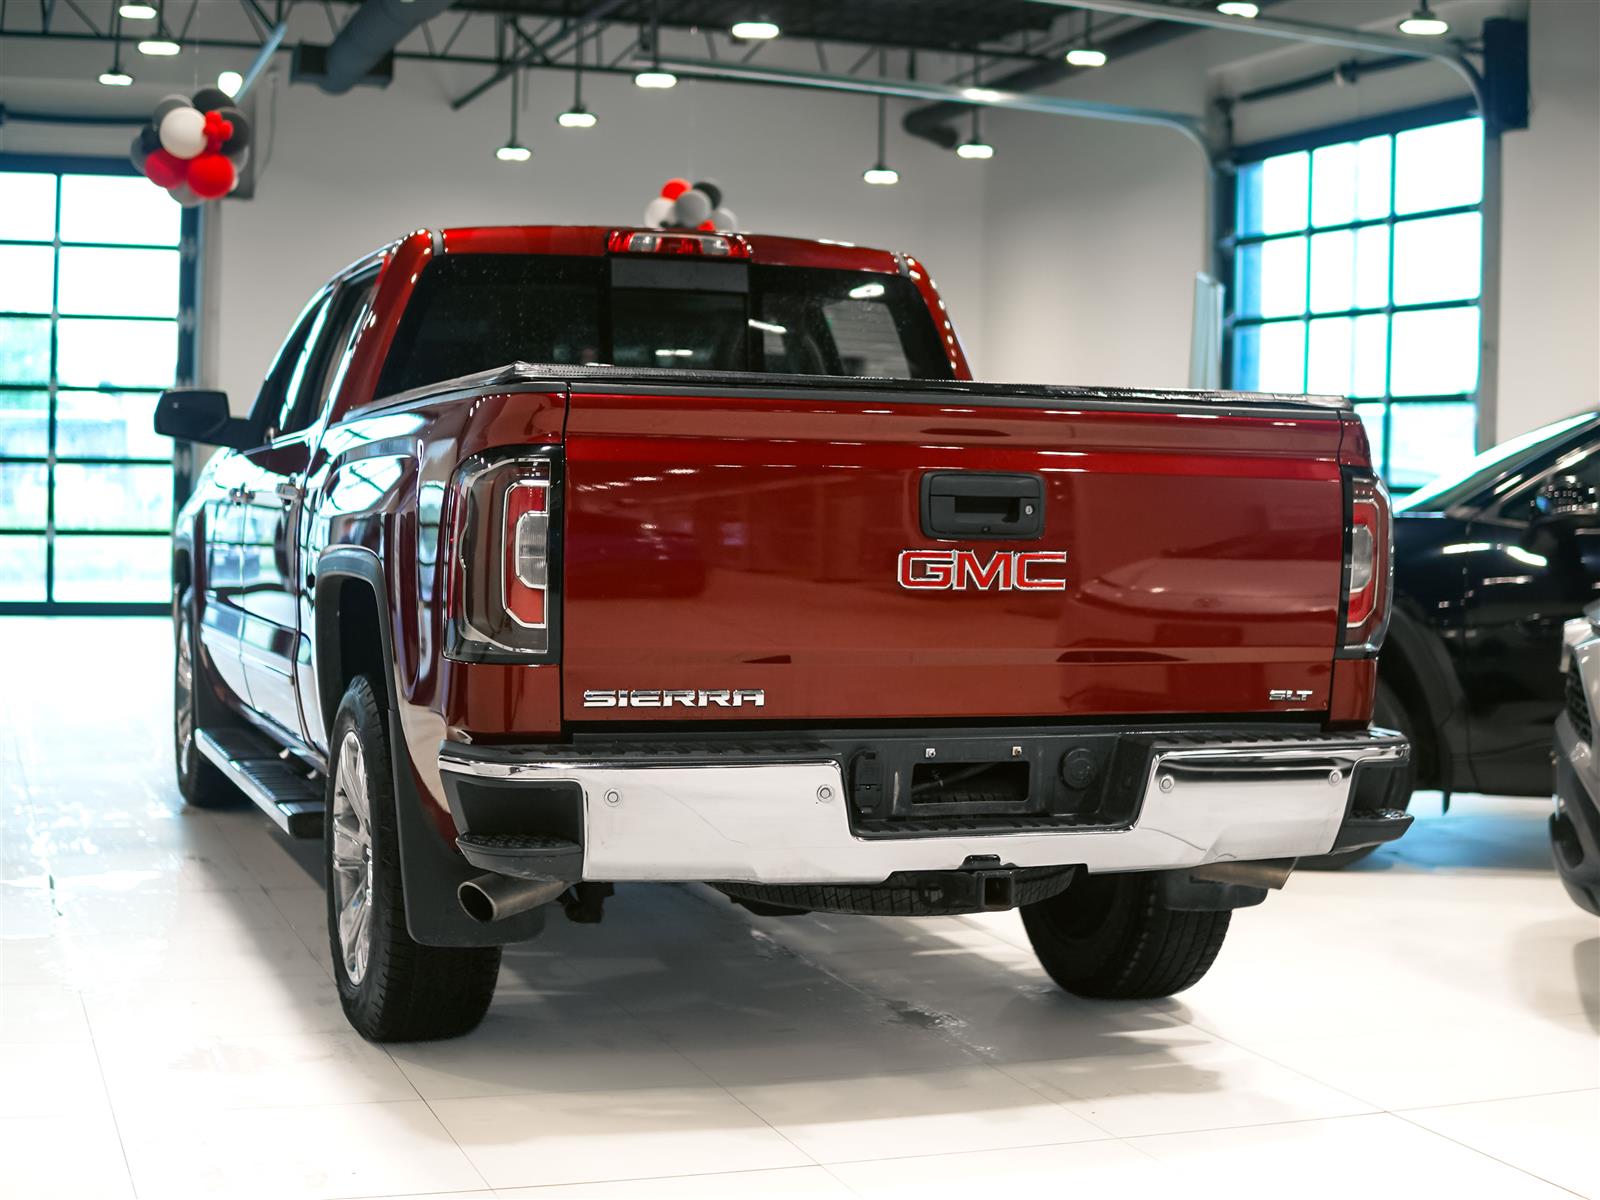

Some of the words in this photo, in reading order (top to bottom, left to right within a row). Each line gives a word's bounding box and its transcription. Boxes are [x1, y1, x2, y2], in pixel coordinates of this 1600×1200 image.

[897, 549, 1067, 590] GMC
[583, 689, 765, 707] SIERRA
[1269, 689, 1313, 701] SLT
